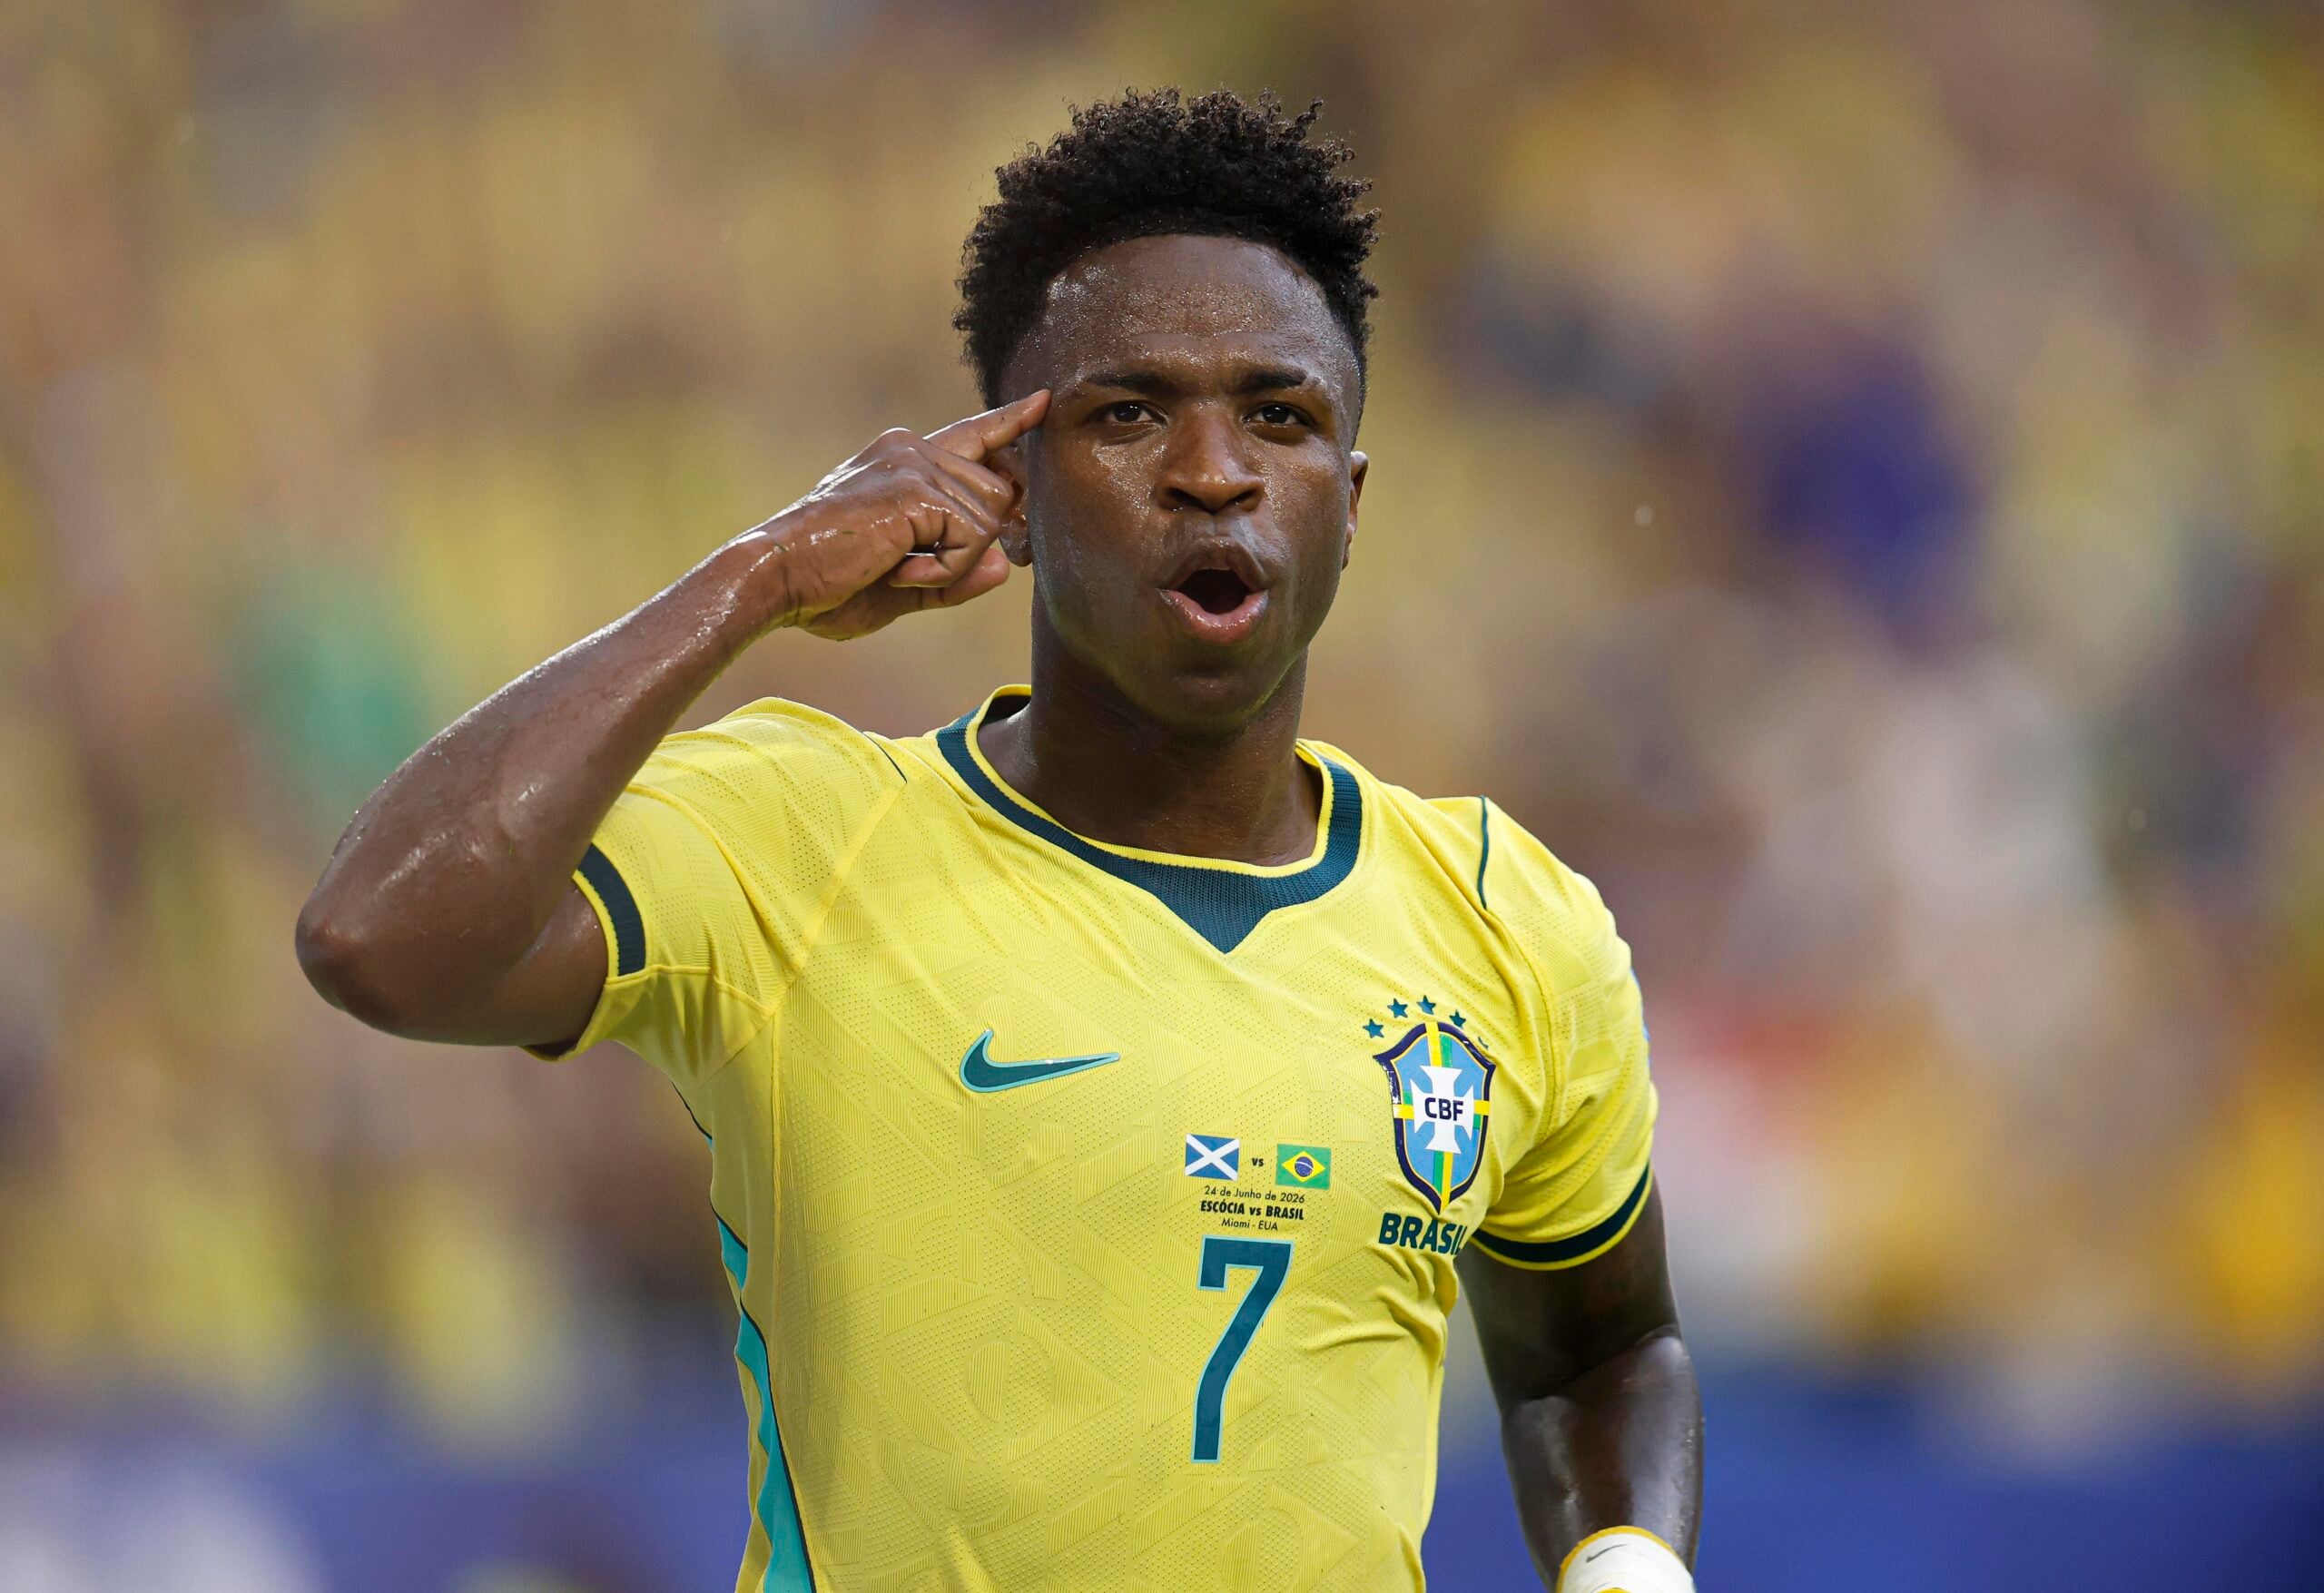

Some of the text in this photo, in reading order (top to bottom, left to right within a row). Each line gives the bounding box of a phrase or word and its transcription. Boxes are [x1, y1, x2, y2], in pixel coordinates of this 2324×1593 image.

[1424, 1096, 1463, 1122] CBF
[1251, 1156, 1265, 1167] vs
[1204, 1185, 1305, 1204] 24 de Junho de 2026
[1200, 1198, 1305, 1220] ESCÓCIA vs BRASIL
[1221, 1217, 1250, 1229] Miami
[1257, 1220, 1278, 1232] EUA
[1191, 1234, 1295, 1463] 7
